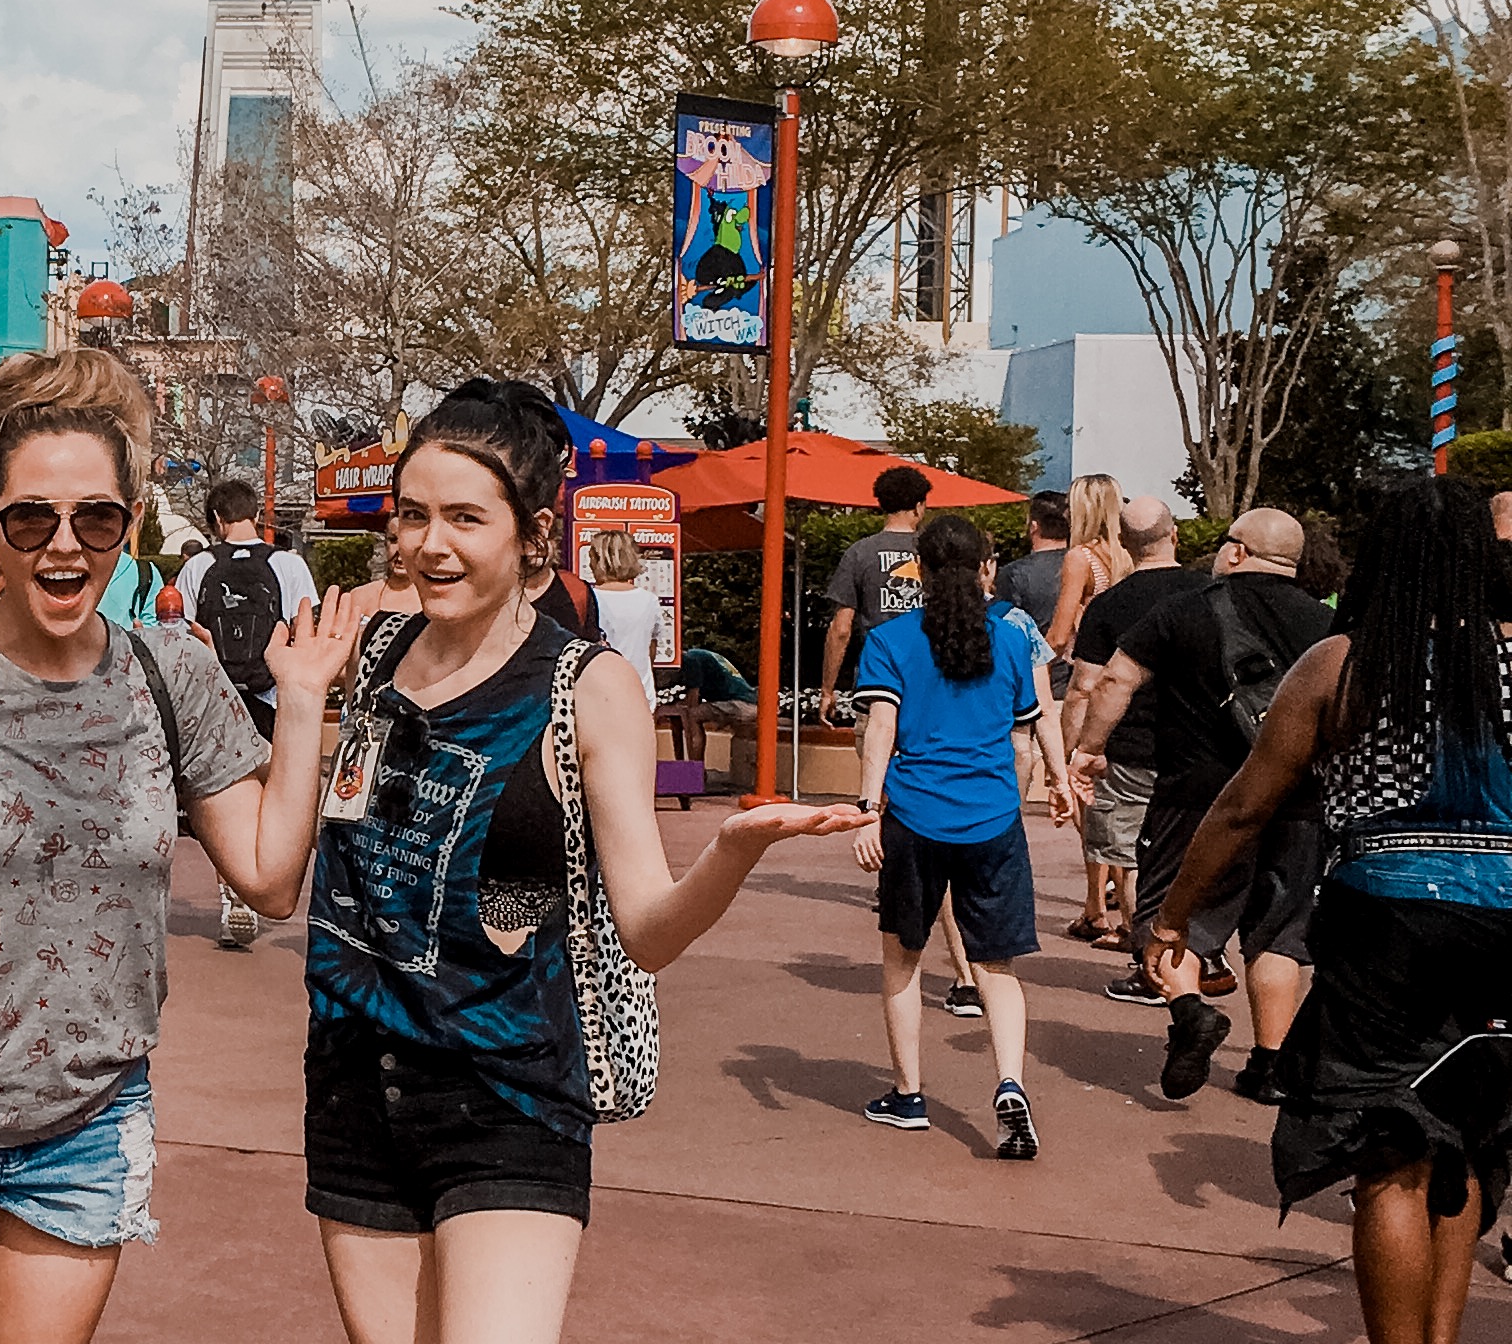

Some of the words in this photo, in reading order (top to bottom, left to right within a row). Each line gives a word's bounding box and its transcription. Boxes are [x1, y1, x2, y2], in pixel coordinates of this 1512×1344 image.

[686, 130, 742, 164] BROOM
[716, 163, 767, 193] HILDA
[336, 467, 360, 489] HAIR
[578, 496, 628, 510] AIRBRUSH
[629, 497, 670, 511] TATTOOS
[633, 532, 674, 544] TATTOOS
[878, 551, 901, 572] THE
[880, 588, 903, 609] DOG
[389, 823, 431, 847] THOSE
[386, 866, 418, 886] FIND
